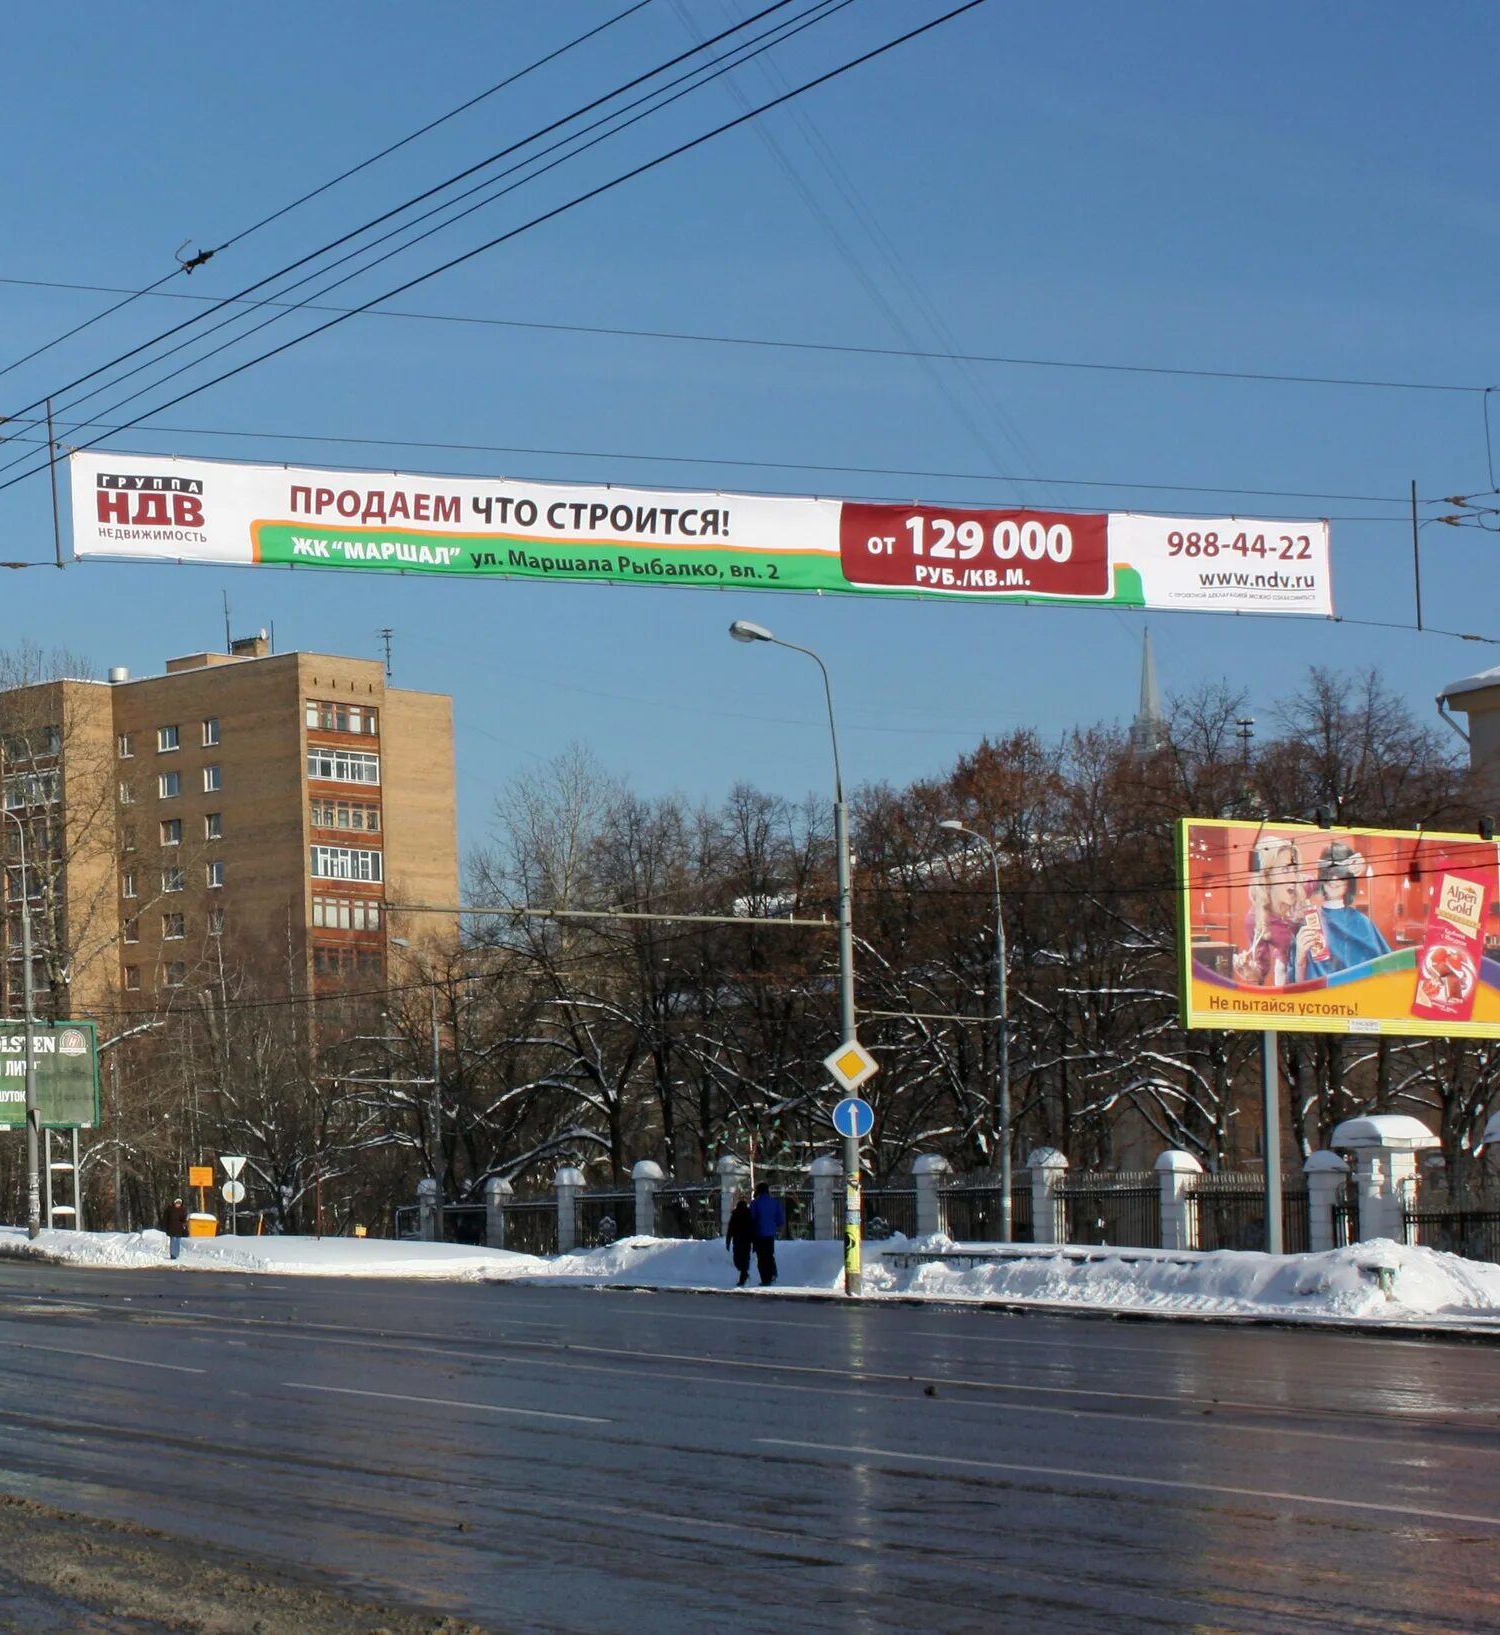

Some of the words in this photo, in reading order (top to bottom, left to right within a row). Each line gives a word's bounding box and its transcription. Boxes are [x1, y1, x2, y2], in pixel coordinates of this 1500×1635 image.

[102, 476, 199, 493] ГРУППА
[96, 490, 205, 527] НДВ
[290, 485, 461, 524] ПРОДАЕМ
[472, 497, 538, 527] ЧТО
[546, 502, 730, 537] СТРОИТСЯ!
[98, 528, 208, 543] НЕДВИЖИМОСТЬ
[867, 537, 896, 555] от
[905, 516, 984, 560] 129
[992, 521, 1073, 563] 000
[1167, 531, 1312, 560] 988-44-22
[291, 537, 331, 557] ЖК
[470, 552, 503, 569] ул.
[508, 550, 612, 572] Маршала
[618, 556, 724, 578] Рыбалко,
[731, 564, 762, 579] вл.
[768, 565, 780, 579] 2
[915, 565, 1031, 587] РУБ./КВ.М.
[1199, 571, 1315, 588] www.ndv.ru
[1447, 885, 1478, 904] Alpen
[1447, 899, 1473, 917] Gold
[1209, 996, 1229, 1010] Не
[1232, 998, 1295, 1013] пытайся
[1298, 1002, 1359, 1016] устоять!
